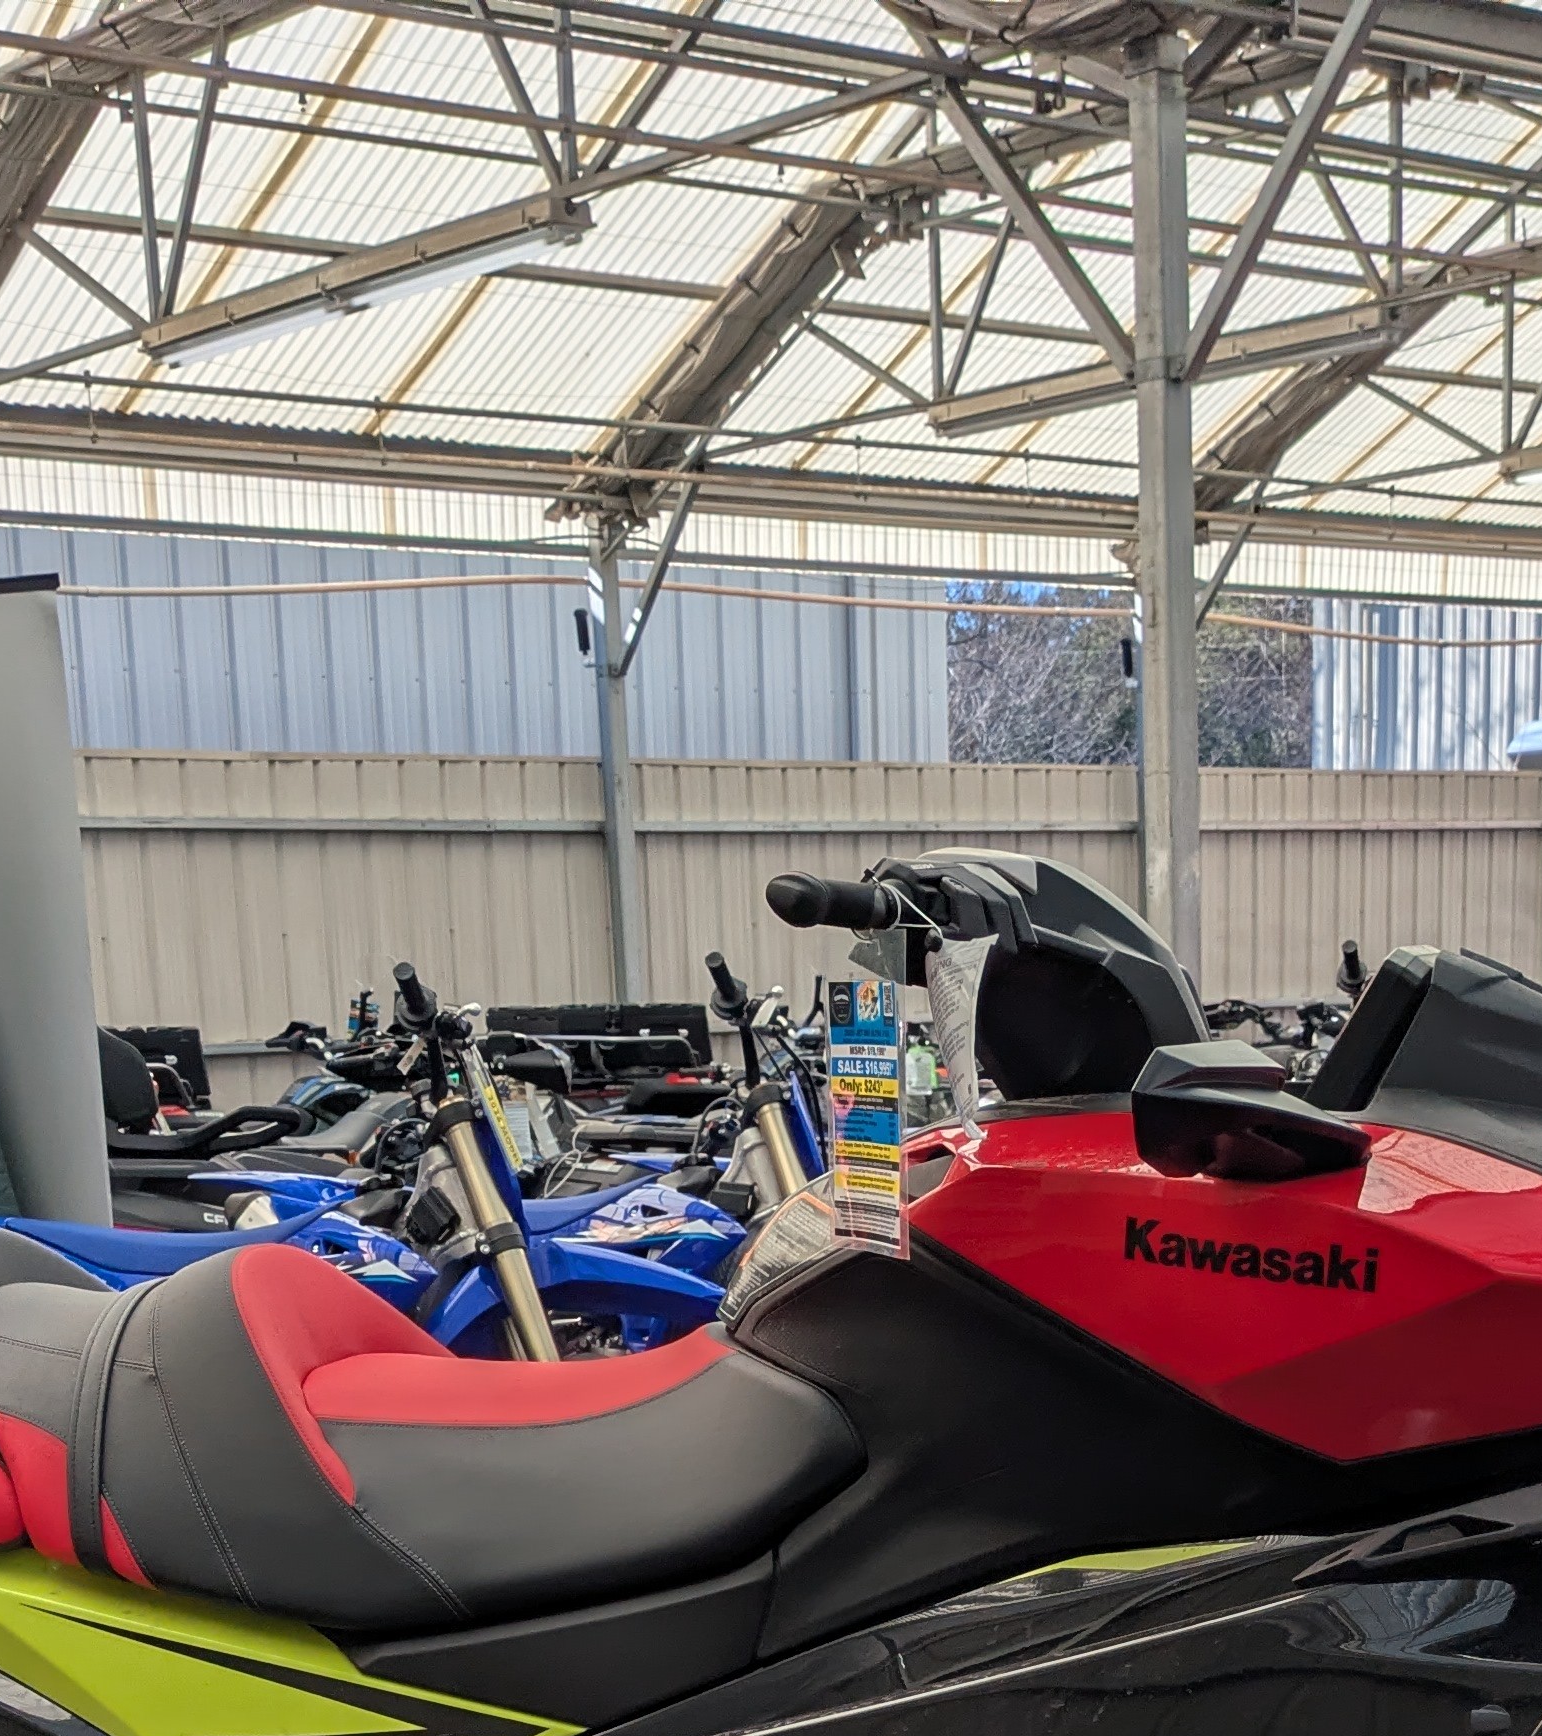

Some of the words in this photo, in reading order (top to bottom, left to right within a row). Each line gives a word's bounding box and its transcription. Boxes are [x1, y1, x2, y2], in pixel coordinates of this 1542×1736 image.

[837, 1060, 863, 1074] SALE:
[839, 1078, 863, 1094] Only:
[1124, 1216, 1380, 1293] Kawasaki
